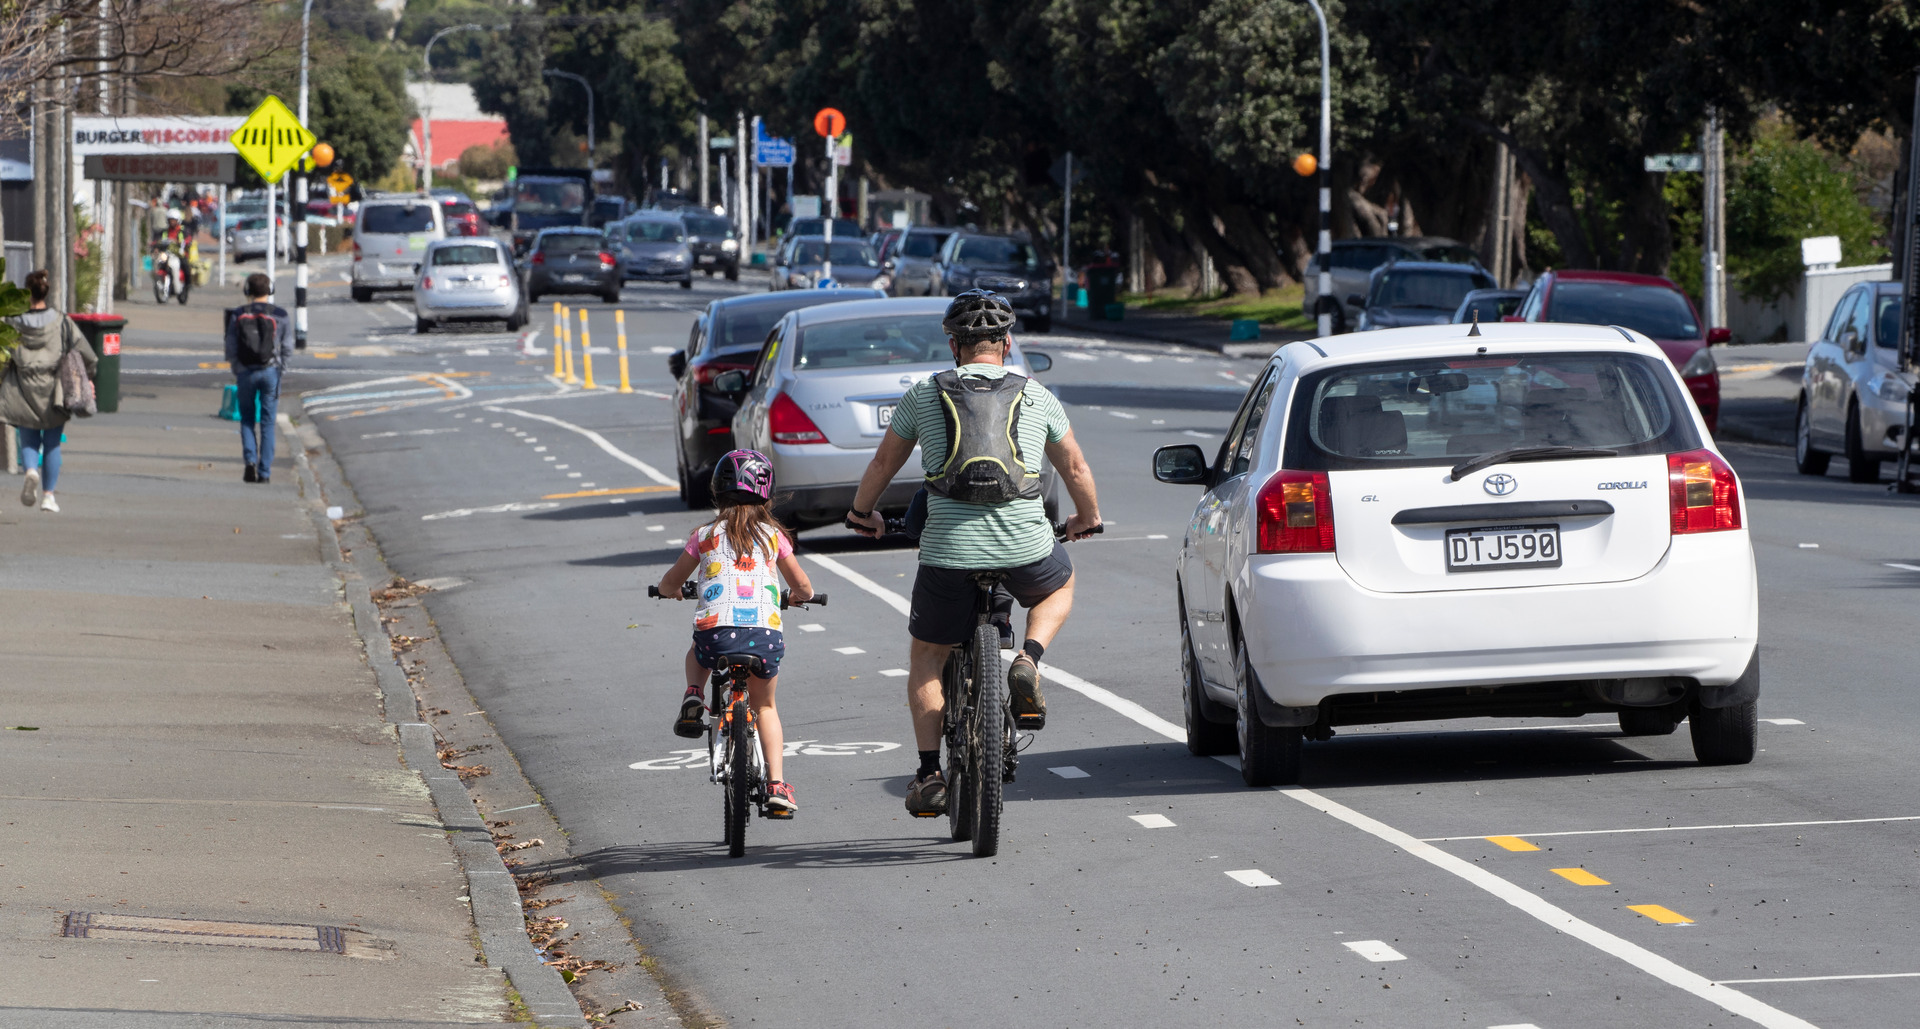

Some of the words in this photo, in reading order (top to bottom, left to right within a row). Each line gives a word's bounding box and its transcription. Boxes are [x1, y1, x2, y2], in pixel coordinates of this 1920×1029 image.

[102, 156, 219, 177] WISCONSIN
[1597, 481, 1648, 490] COROLLA
[1361, 494, 1380, 503] GL
[1452, 533, 1555, 562] DTJ590
[737, 561, 752, 569] YAY
[705, 586, 720, 599] OK
